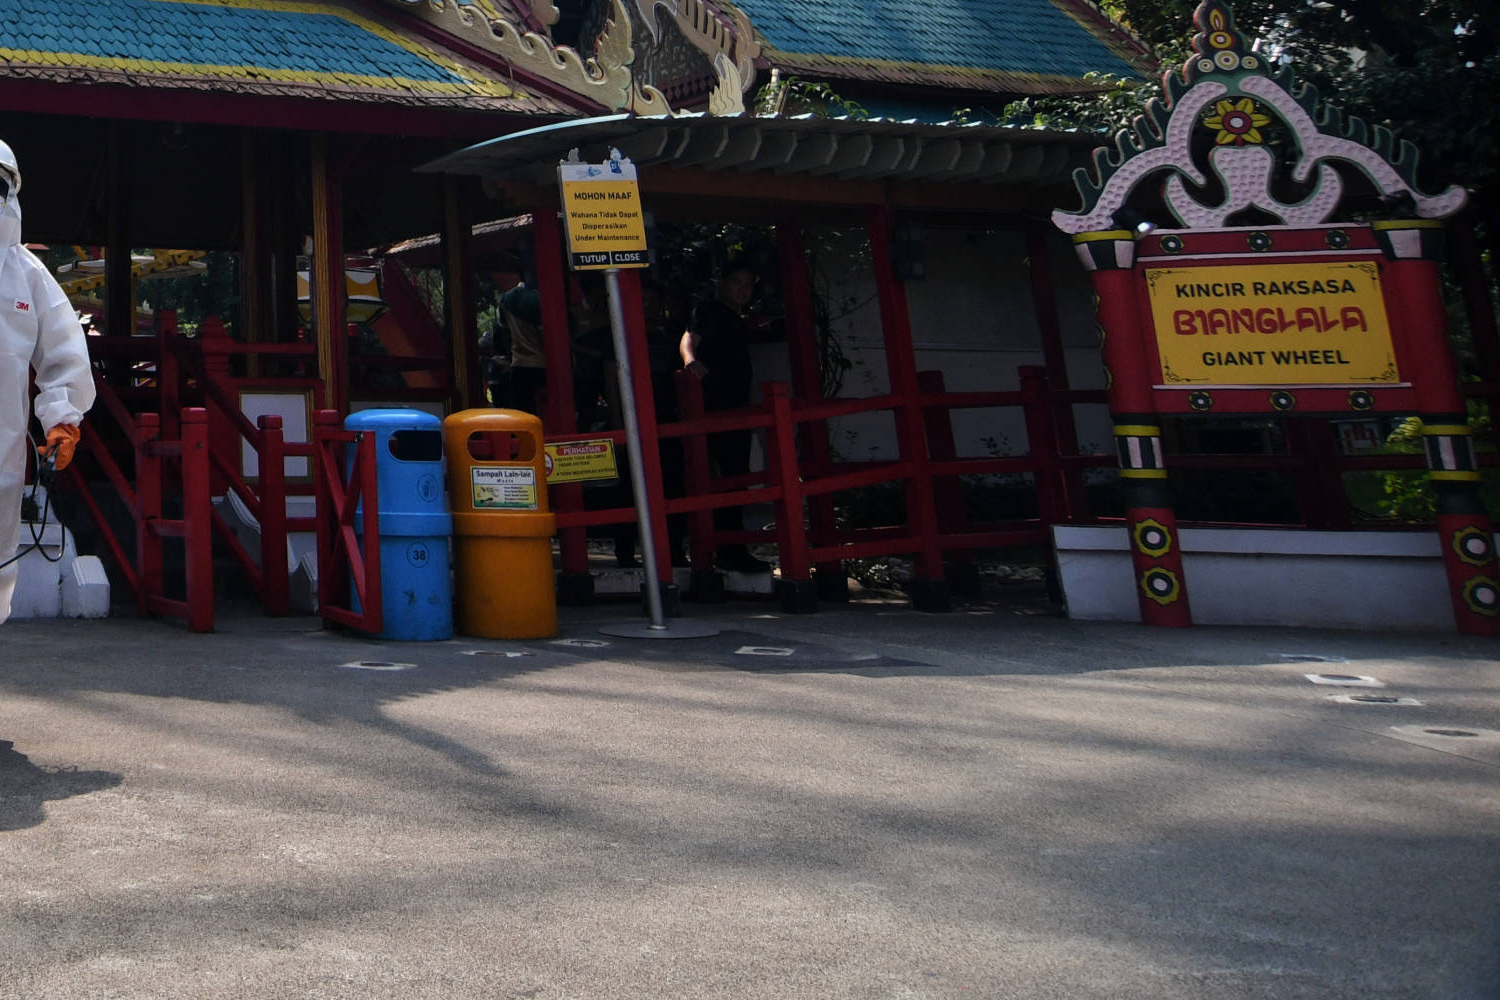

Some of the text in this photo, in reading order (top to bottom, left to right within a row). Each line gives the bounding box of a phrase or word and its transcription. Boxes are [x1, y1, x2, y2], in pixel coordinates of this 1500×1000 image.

[574, 192, 632, 200] MOHON MAAF
[580, 253, 640, 262] TUTUP CLOSE
[1175, 279, 1356, 298] KINCIR RAKSASA
[16, 301, 29, 311] 3M
[1173, 306, 1367, 335] BIANGLALA
[1202, 350, 1350, 367] GIANT WHEEL
[476, 470, 503, 478] Sampah
[412, 550, 426, 560] 38
